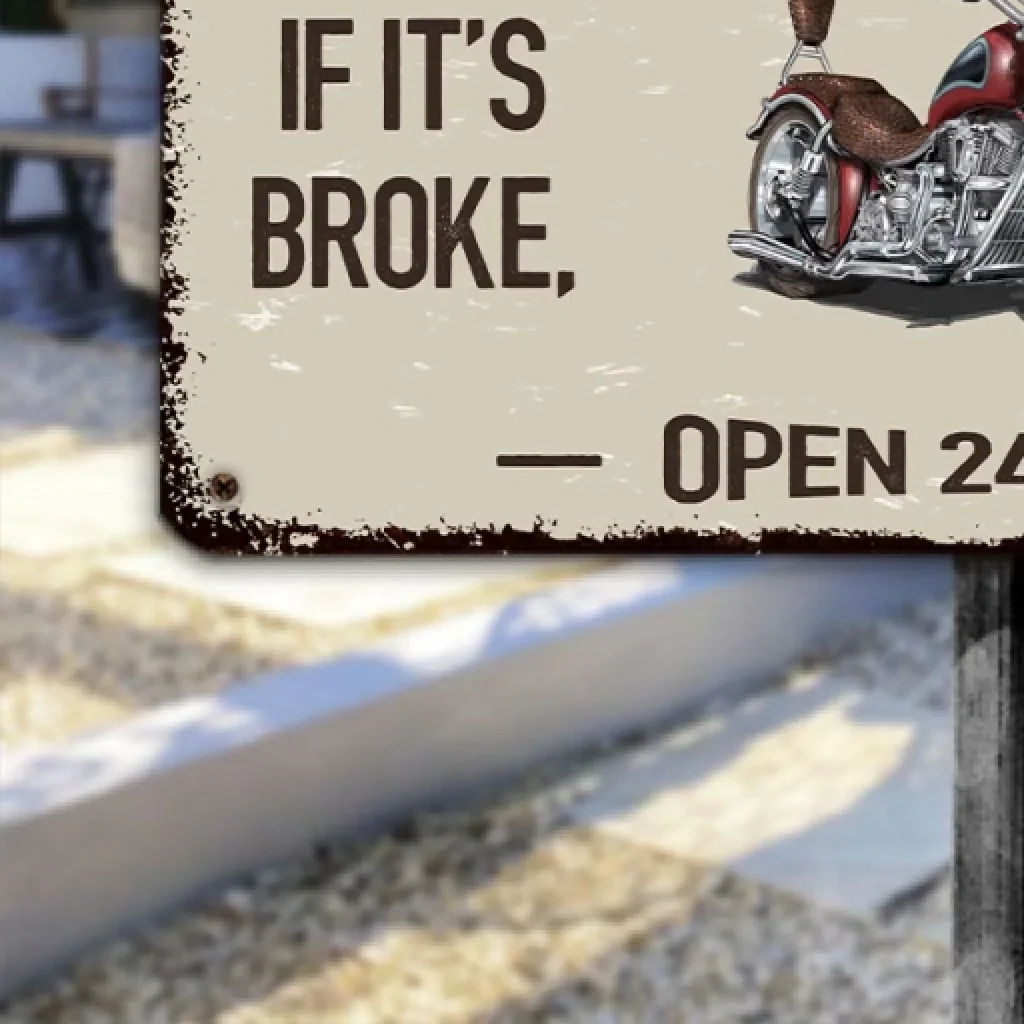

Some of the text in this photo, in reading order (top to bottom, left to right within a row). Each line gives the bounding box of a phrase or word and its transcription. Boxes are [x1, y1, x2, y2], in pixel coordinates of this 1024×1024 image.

[280, 16, 548, 132] IF IT'S
[250, 174, 576, 300] BROKE,
[662, 412, 908, 506] OPEN
